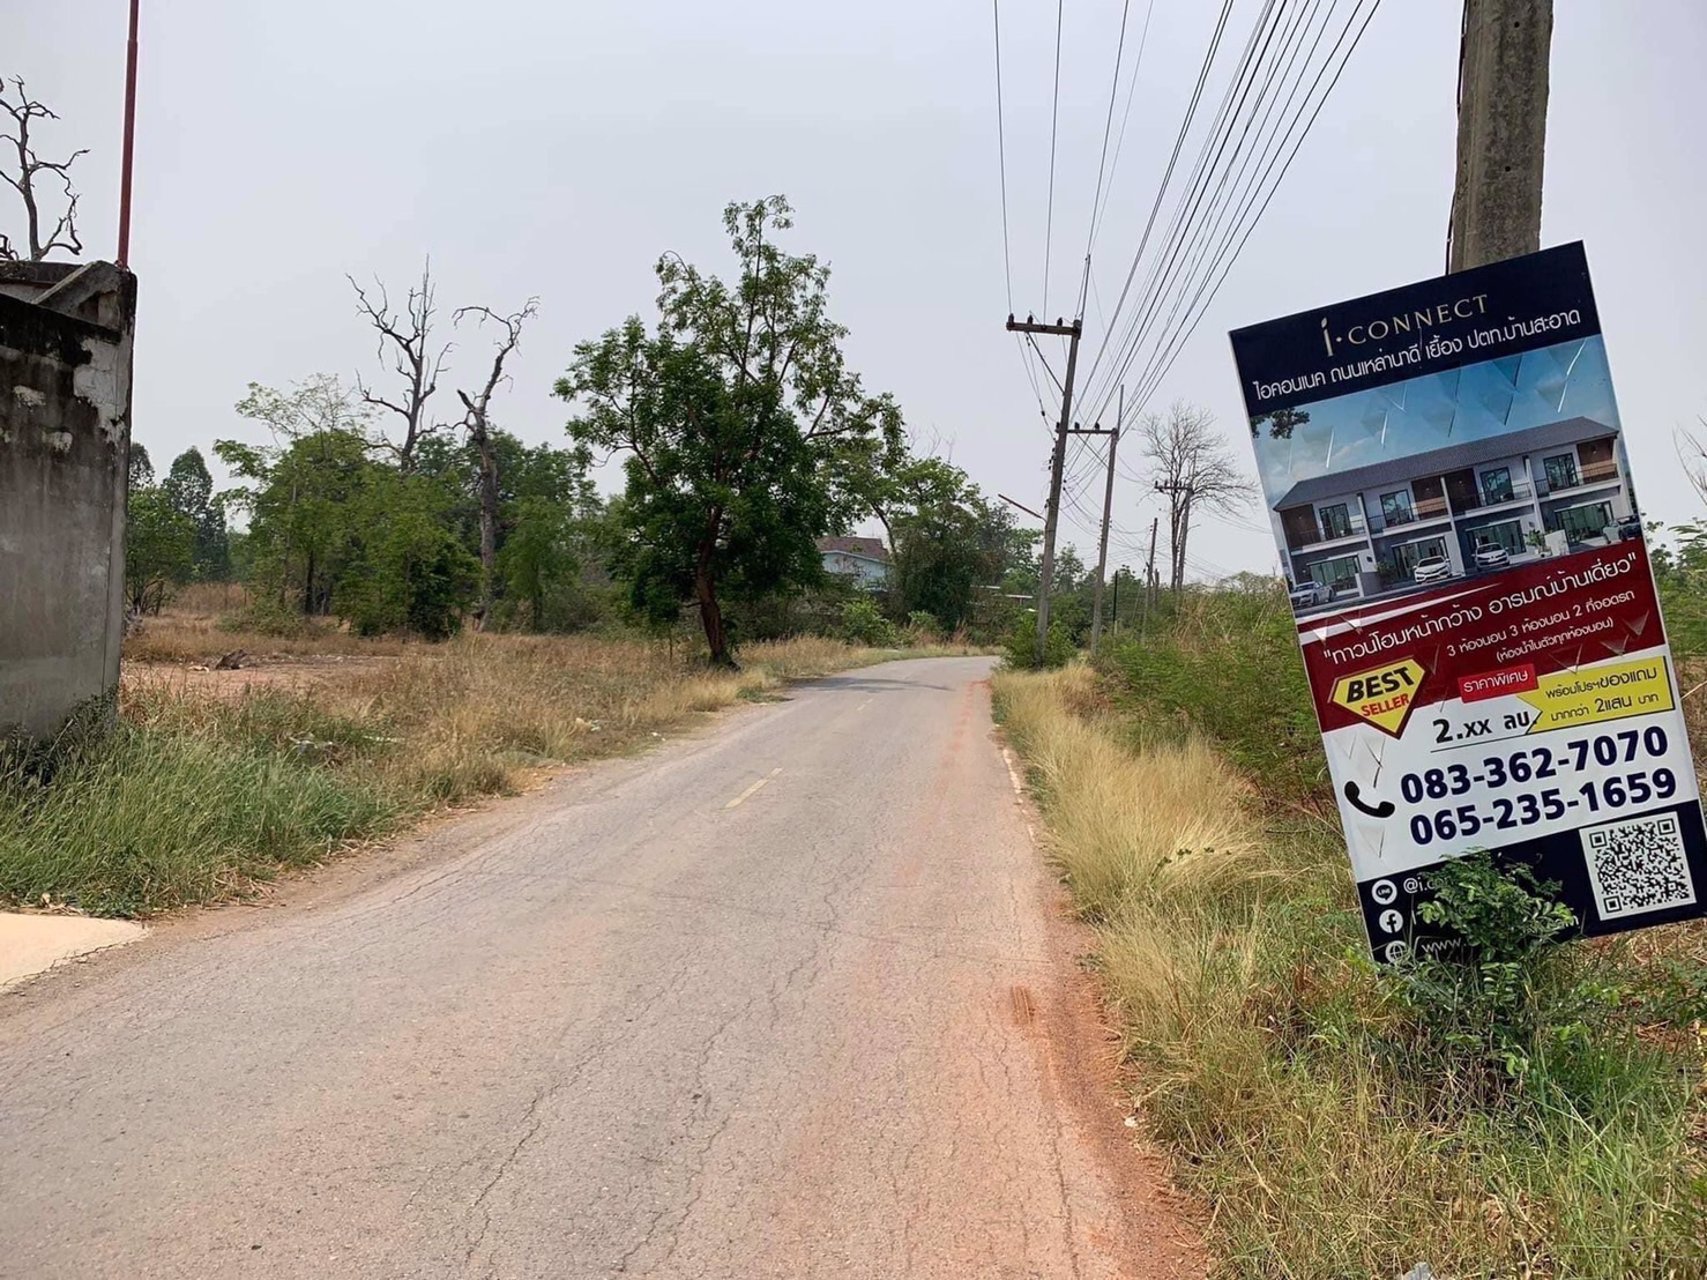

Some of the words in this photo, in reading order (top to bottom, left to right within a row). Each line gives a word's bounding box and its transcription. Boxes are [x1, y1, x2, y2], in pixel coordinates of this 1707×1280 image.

[1252, 371, 1327, 401] ไอคอนเนค
[1331, 343, 1422, 383] ถนนเหล่านาดี
[1425, 334, 1463, 359] เยื้อง
[1467, 309, 1581, 349] ปตท.บ้านสะอาด
[1488, 552, 1637, 614] อารมณ์บ้านเดี่ยว"
[1446, 645, 1457, 657] 3
[1459, 629, 1507, 654] ห้องนอน
[1510, 625, 1519, 637] 3
[1521, 609, 1571, 634] ห้องนอน
[1573, 604, 1584, 617] 2
[1586, 589, 1636, 614] ที่จอดรถ
[1346, 666, 1415, 703] BEST
[1361, 692, 1410, 717] SELLER
[1463, 669, 1529, 693] ราคาพิเศษ
[1432, 718, 1493, 744] 2.xx
[1551, 705, 1590, 722] มากกว่า
[1637, 692, 1660, 705] บาท
[1400, 725, 1669, 804] 083-362-7070
[1410, 767, 1677, 845] 065-235-1659
